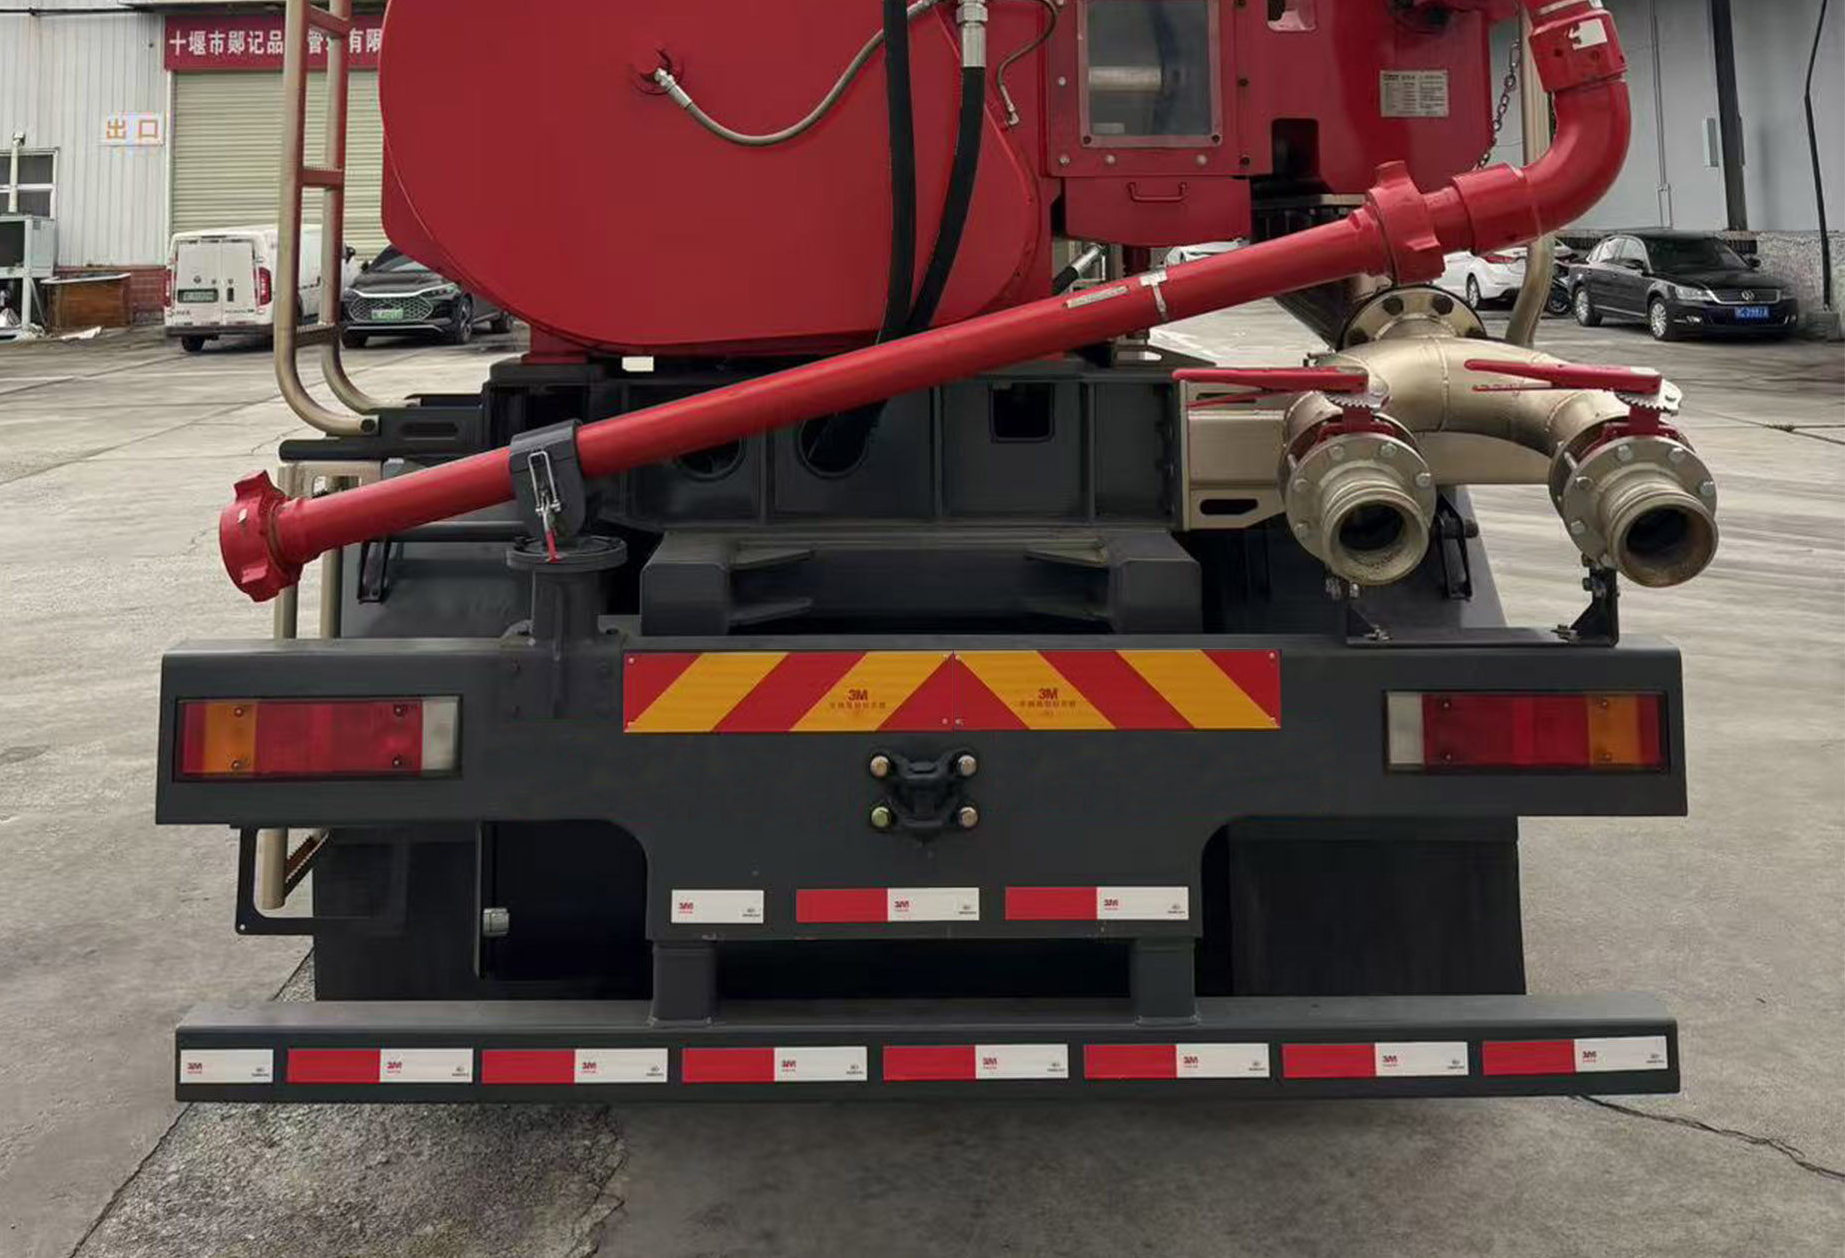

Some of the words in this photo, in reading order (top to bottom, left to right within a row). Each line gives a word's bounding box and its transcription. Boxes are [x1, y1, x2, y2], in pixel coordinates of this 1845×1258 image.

[106, 118, 159, 140] 出口
[848, 689, 868, 700] 3M
[1038, 688, 1058, 700] 3M
